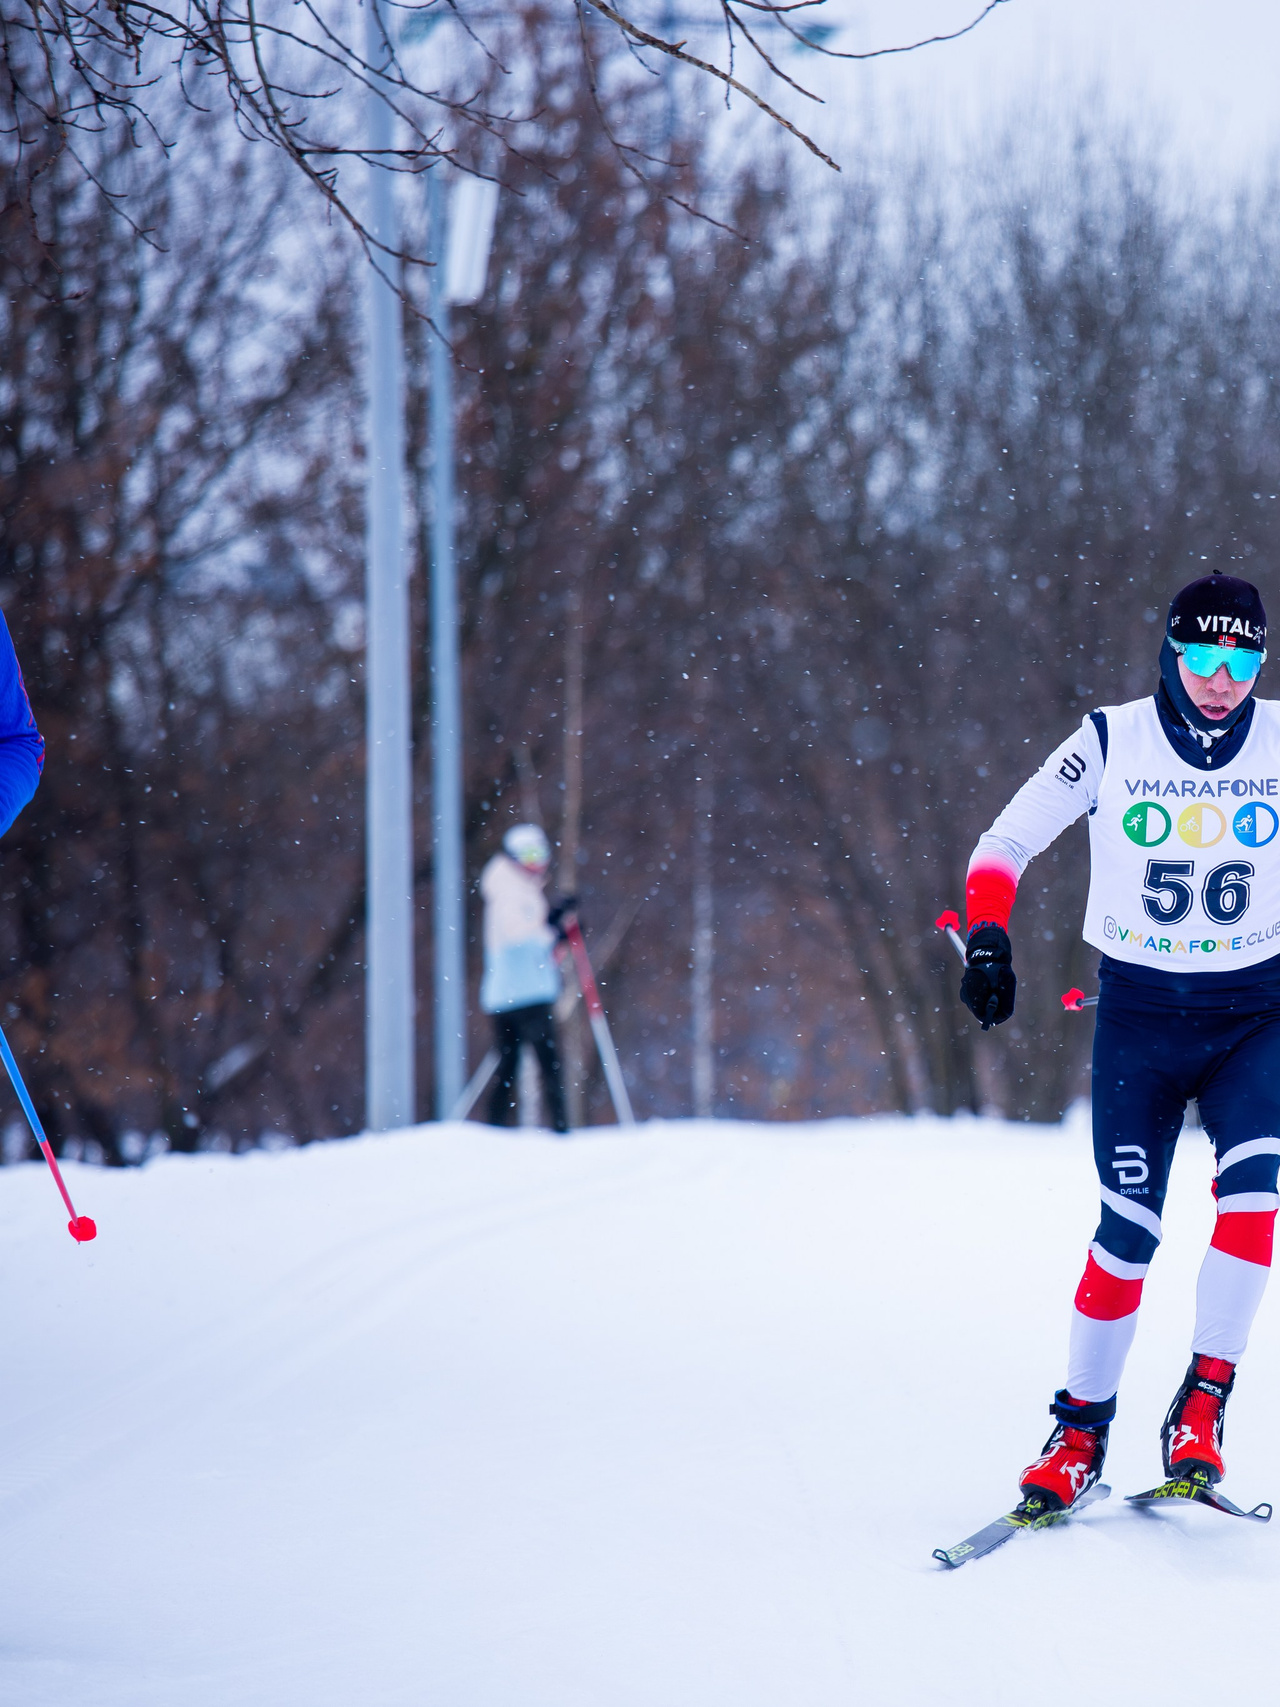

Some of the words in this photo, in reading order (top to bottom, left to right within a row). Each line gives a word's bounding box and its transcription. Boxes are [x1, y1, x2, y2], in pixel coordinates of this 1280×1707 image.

[1196, 614, 1254, 638] VITAL
[1124, 778, 1279, 798] VMARAFONE
[1141, 859, 1255, 926] 56
